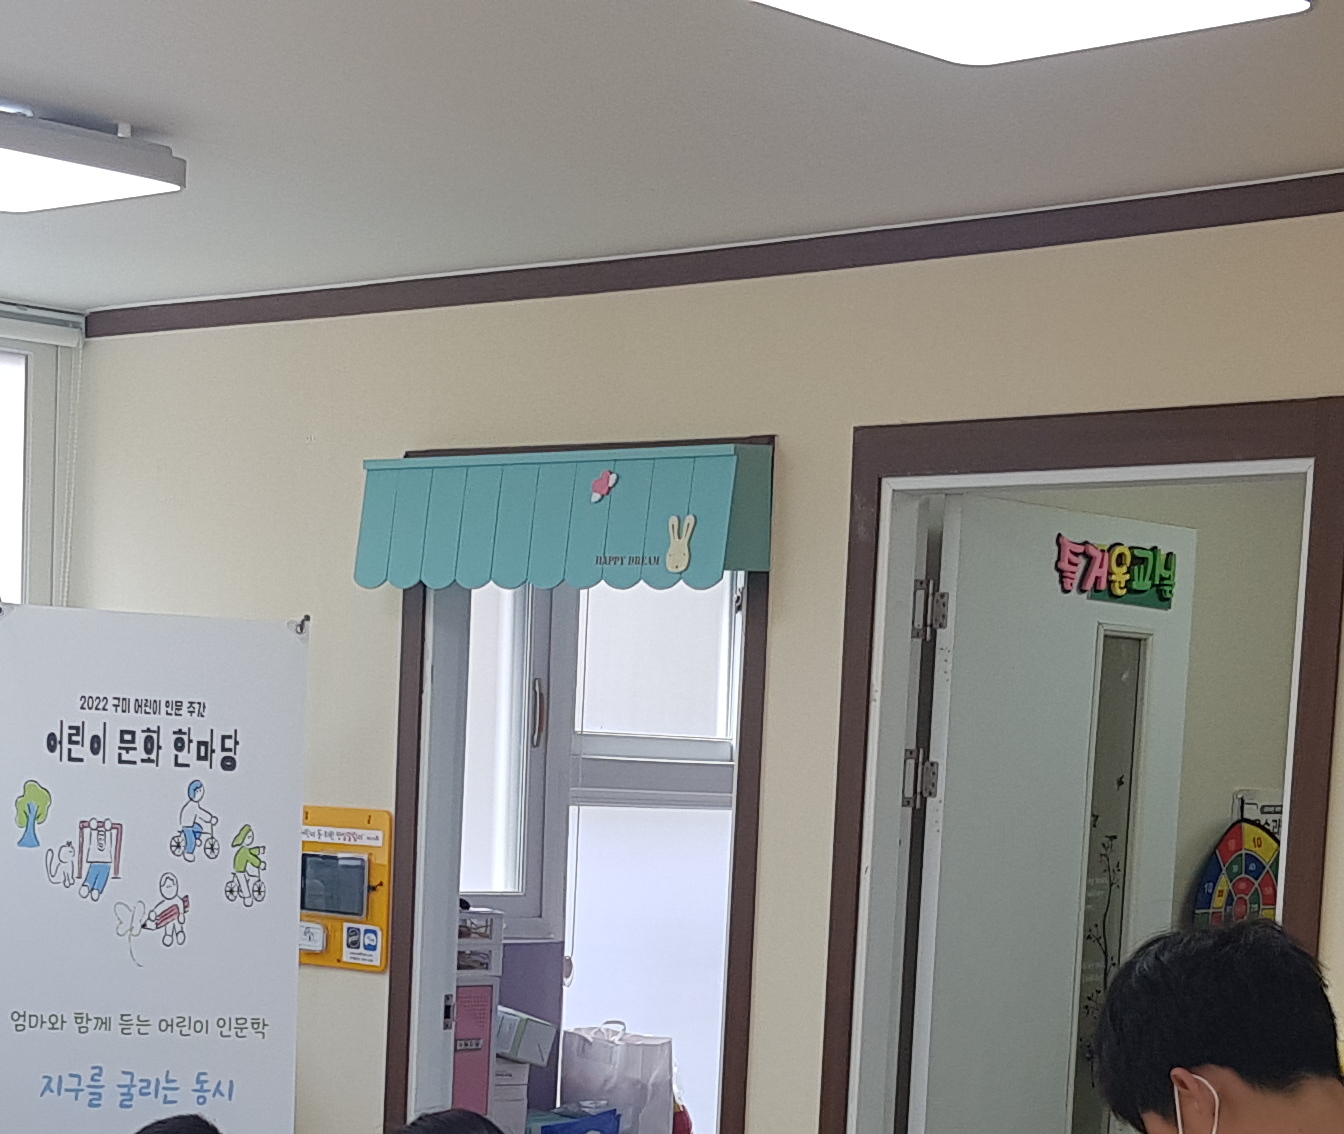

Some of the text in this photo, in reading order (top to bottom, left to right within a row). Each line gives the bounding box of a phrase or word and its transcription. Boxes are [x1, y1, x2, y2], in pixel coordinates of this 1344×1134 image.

[595, 555, 660, 566] HAPPY DREAM
[79, 695, 207, 718] 2022 구미 어린이 인문 주간
[46, 719, 240, 772] 어린이 문화 한마당
[10, 1010, 269, 1040] 엄마와 함께 듣는 어린이 인문학
[39, 1065, 235, 1109] 지구를 굴리는 동시
